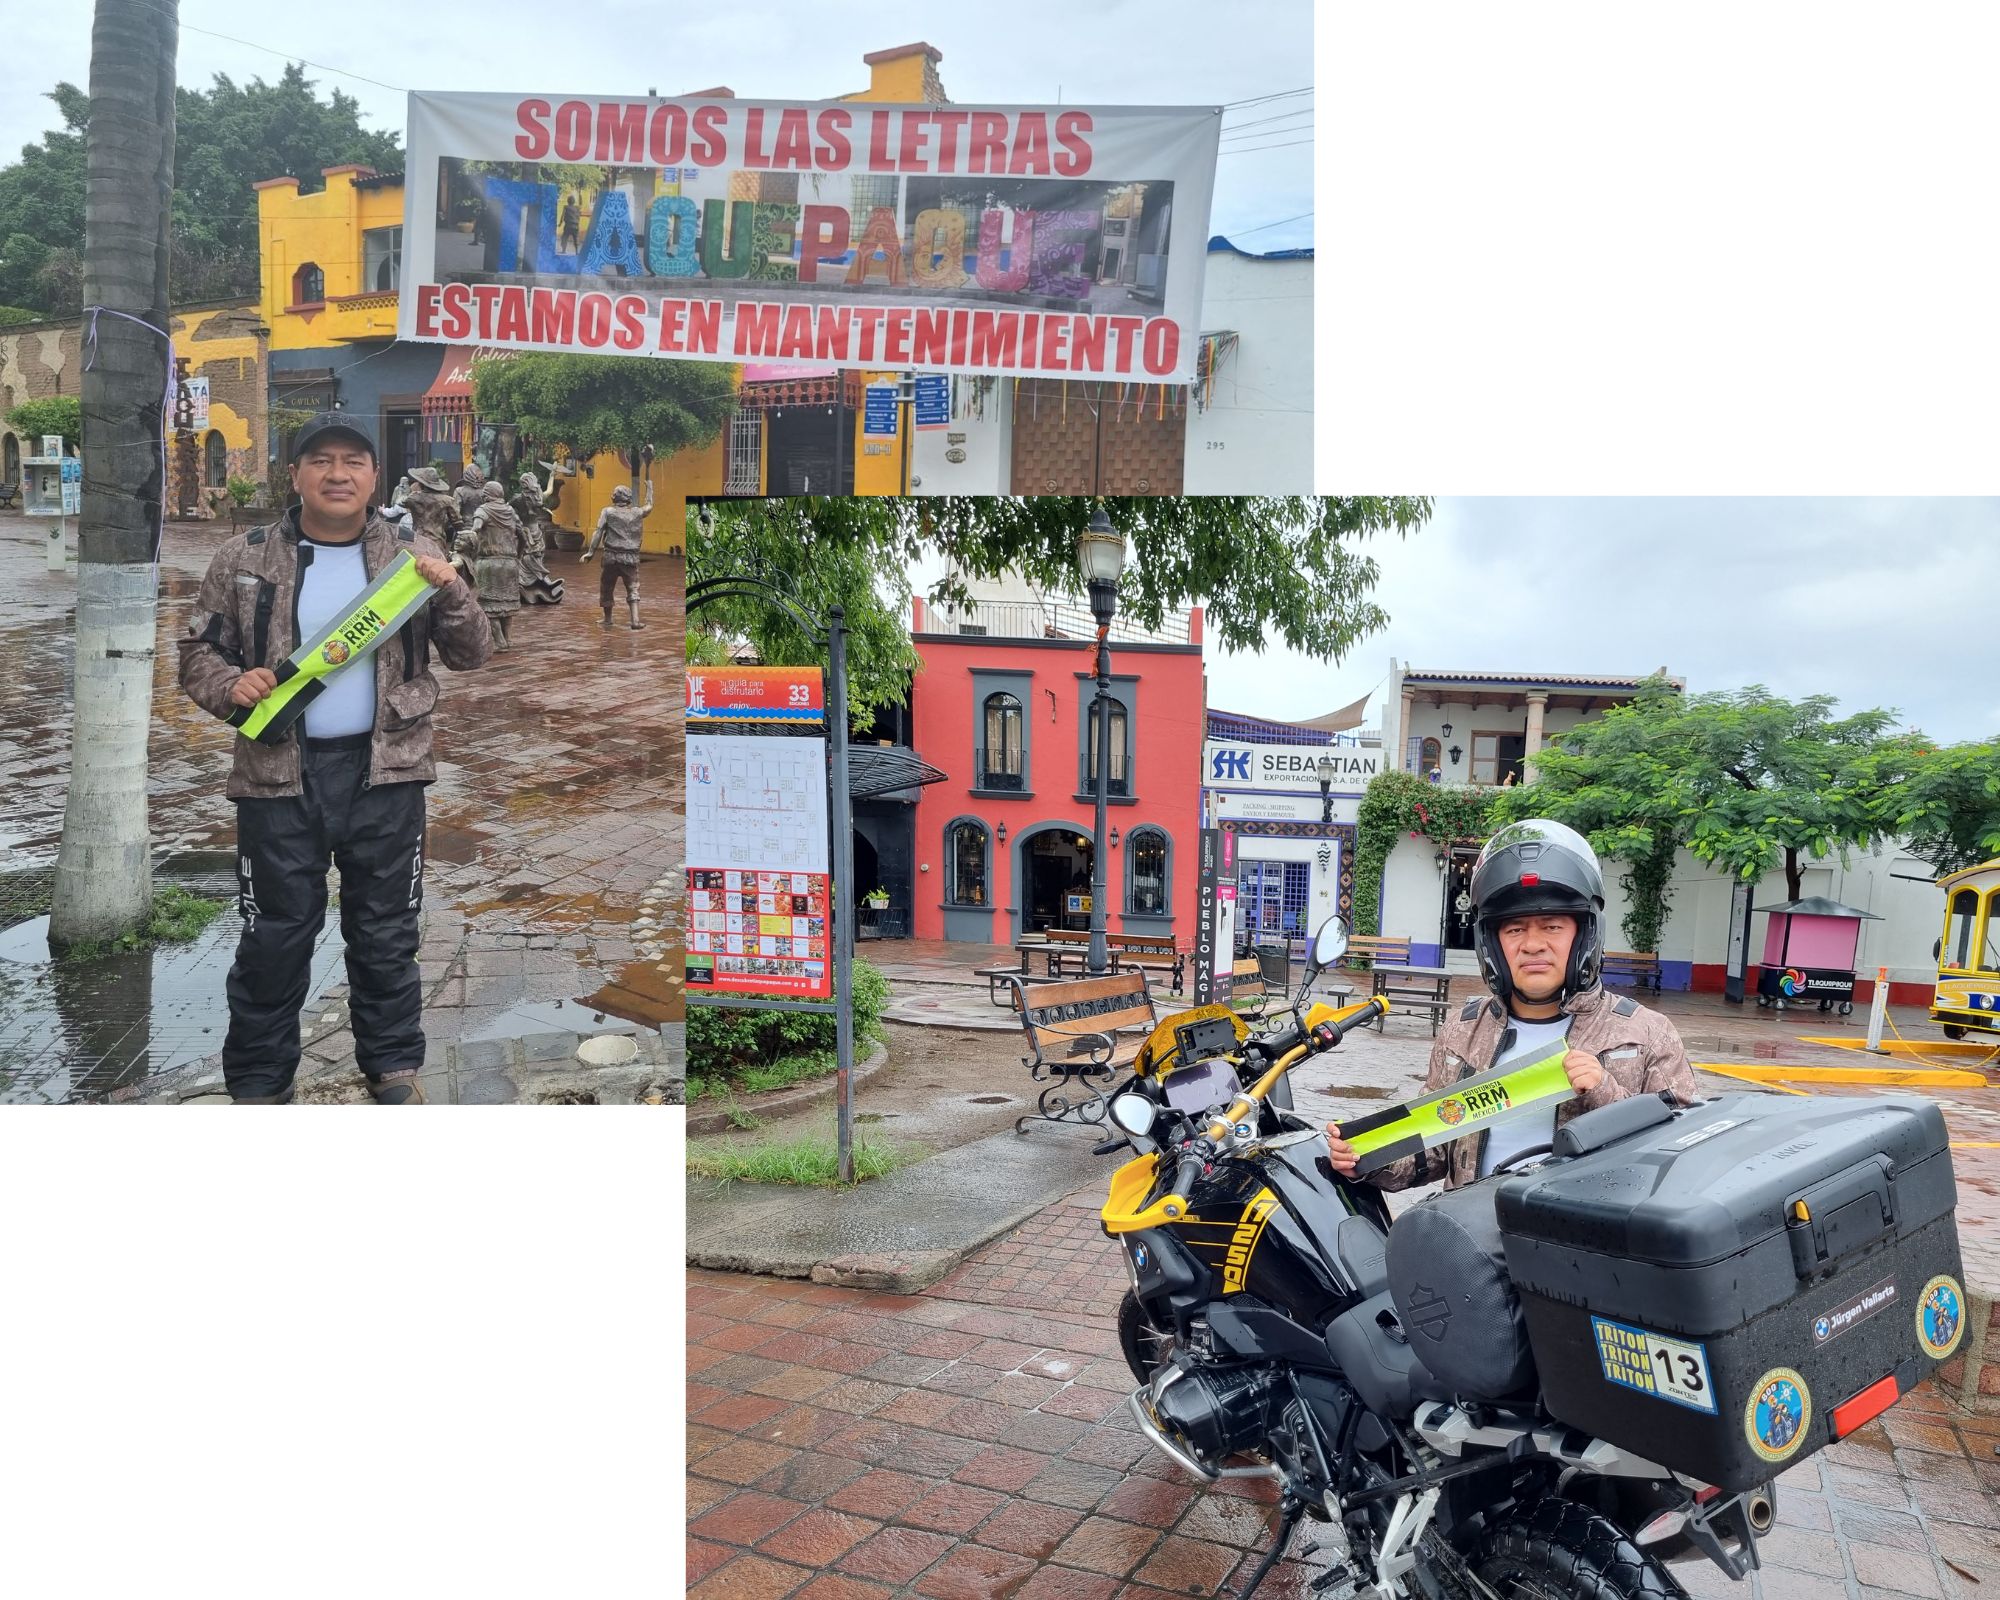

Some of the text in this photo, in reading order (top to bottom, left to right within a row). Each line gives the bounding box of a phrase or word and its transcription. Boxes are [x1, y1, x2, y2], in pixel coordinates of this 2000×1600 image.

[514, 98, 1093, 177] SOMOS LAS LETRAS
[483, 176, 1091, 300] TLAQUEPAQUE
[415, 283, 1180, 376] ESTAMOS EN MANTENIMIENTO
[1206, 441, 1225, 449] 295
[344, 609, 381, 645] RRM
[789, 684, 810, 702] 33
[1264, 773, 1321, 783] EXPORTACION
[1349, 777, 1361, 785] DE
[1200, 886, 1211, 954] PUEBLO
[1199, 959, 1210, 1003] MÁGI
[1462, 1080, 1502, 1098] MOTOTURISTA
[1465, 1086, 1509, 1111] RRM
[1223, 1202, 1275, 1284] 1250
[1831, 1285, 1896, 1329] Jürgen Vallarta
[1596, 1324, 1646, 1351] TRITON
[1601, 1343, 1651, 1371] TRITON
[1655, 1348, 1704, 1392] 13
[1771, 1368, 1796, 1379] RALLY
[1605, 1362, 1655, 1393] TRITON
